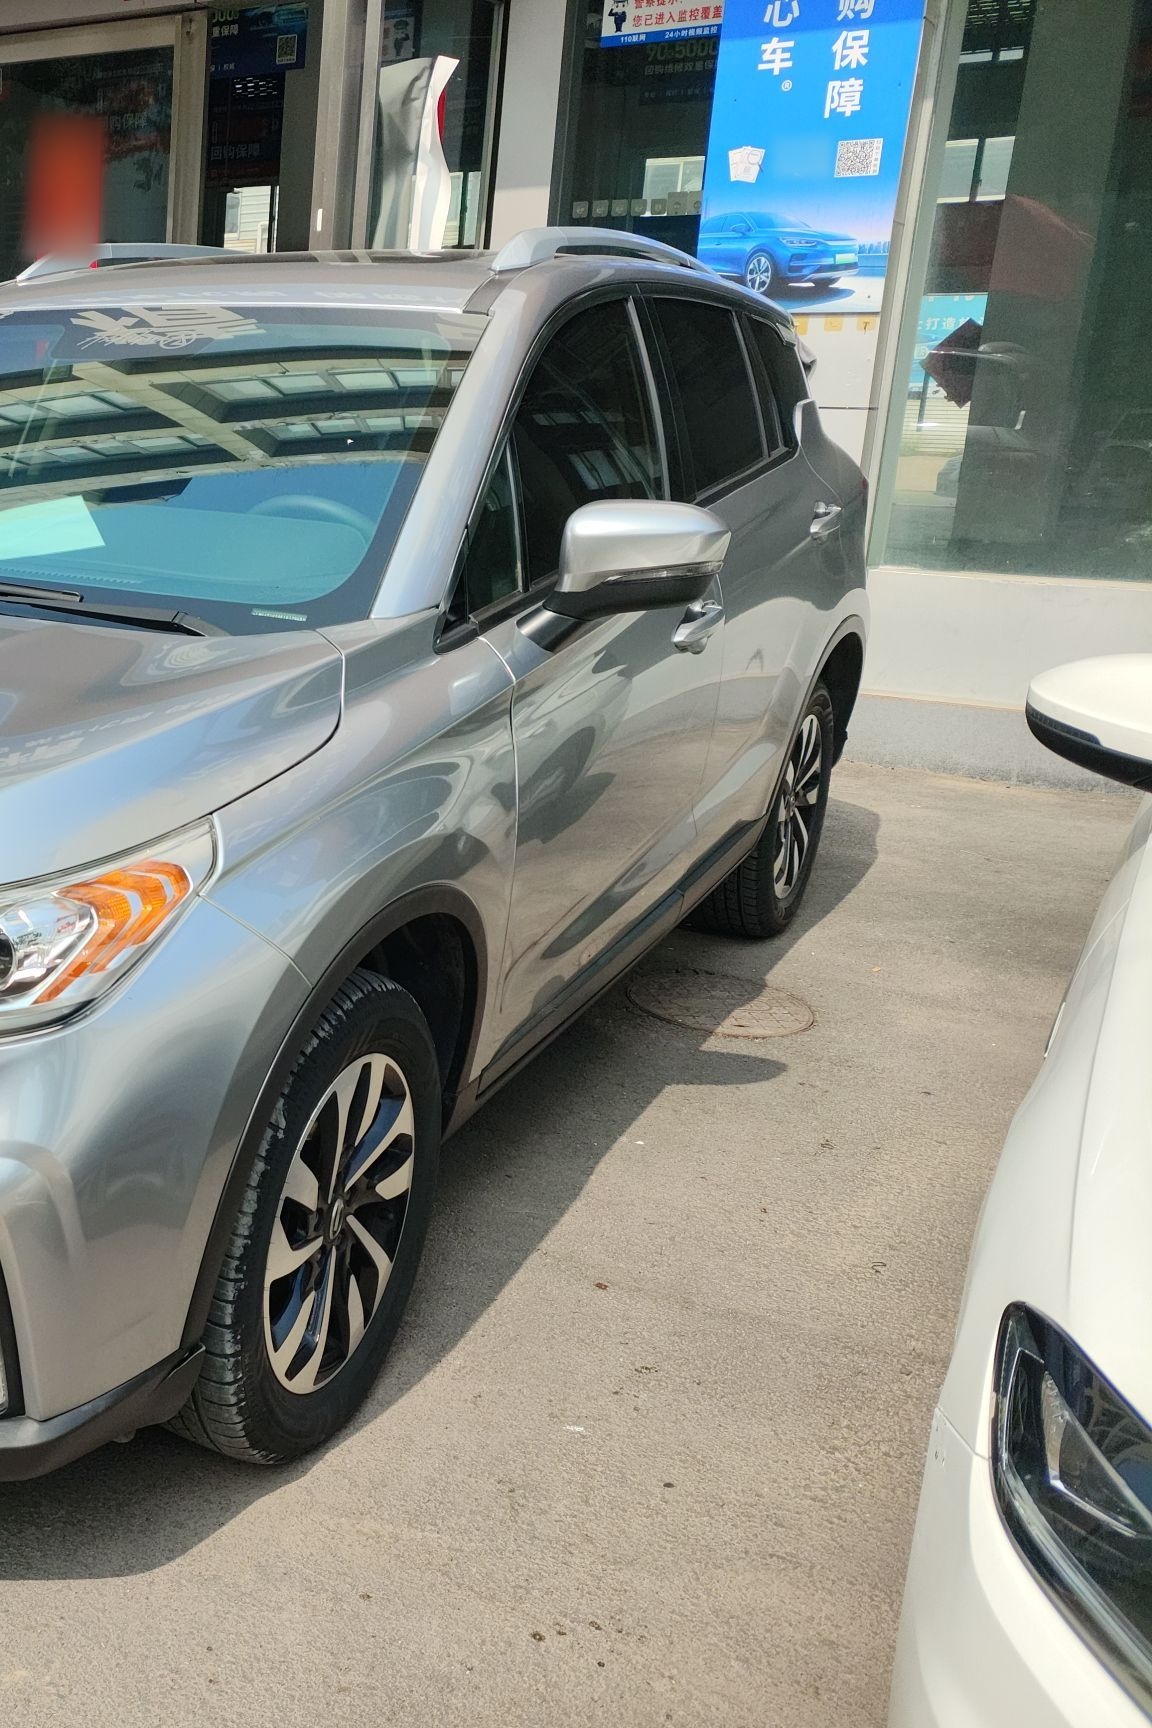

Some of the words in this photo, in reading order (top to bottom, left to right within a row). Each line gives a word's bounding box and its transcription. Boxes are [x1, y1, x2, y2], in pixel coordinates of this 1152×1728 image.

[633, 5, 723, 27] 您已进入监控覆盖
[620, 34, 646, 43] 110联网
